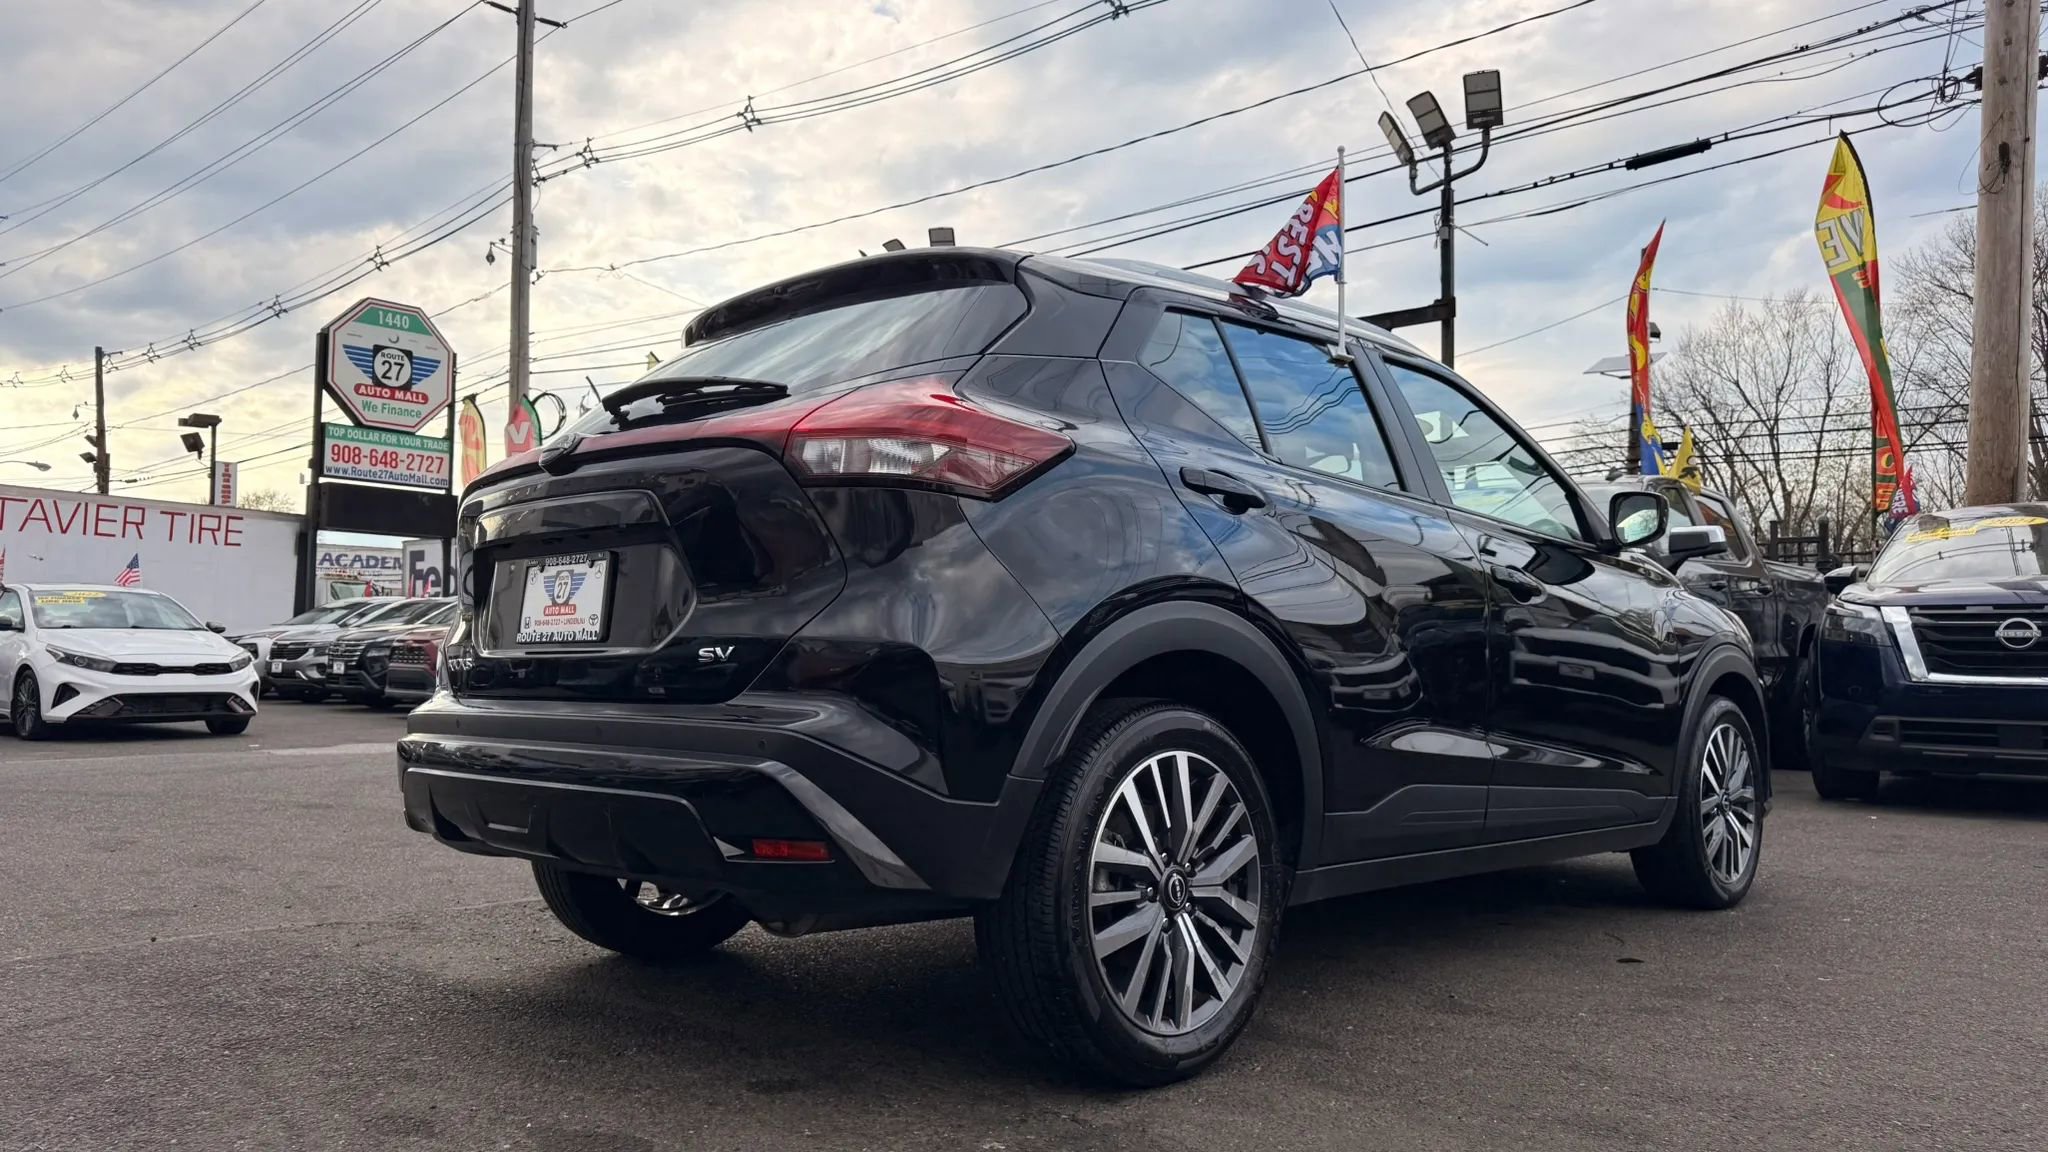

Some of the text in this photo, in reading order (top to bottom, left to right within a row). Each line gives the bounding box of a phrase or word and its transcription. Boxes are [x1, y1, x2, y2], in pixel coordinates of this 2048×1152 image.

[378, 310, 409, 328] 1440
[380, 352, 405, 362] ROUTE
[380, 360, 405, 381] 27
[358, 385, 426, 403] AUTO MALL
[361, 400, 422, 419] We Finance
[328, 426, 449, 450] TOP DOLLAR FOR YOUR TRADE
[331, 443, 444, 474] 908-648-2727
[325, 466, 448, 487] www.Route27AutoMall.com
[160, 510, 244, 547] TIRE
[545, 554, 588, 567] 908-648-2727
[556, 581, 568, 599] 27
[544, 605, 575, 615] AUTO MALL
[516, 630, 598, 642] ROUTE 27 AUTO MALL
[1995, 629, 2041, 638] NISSAN
[698, 645, 735, 663] SV
